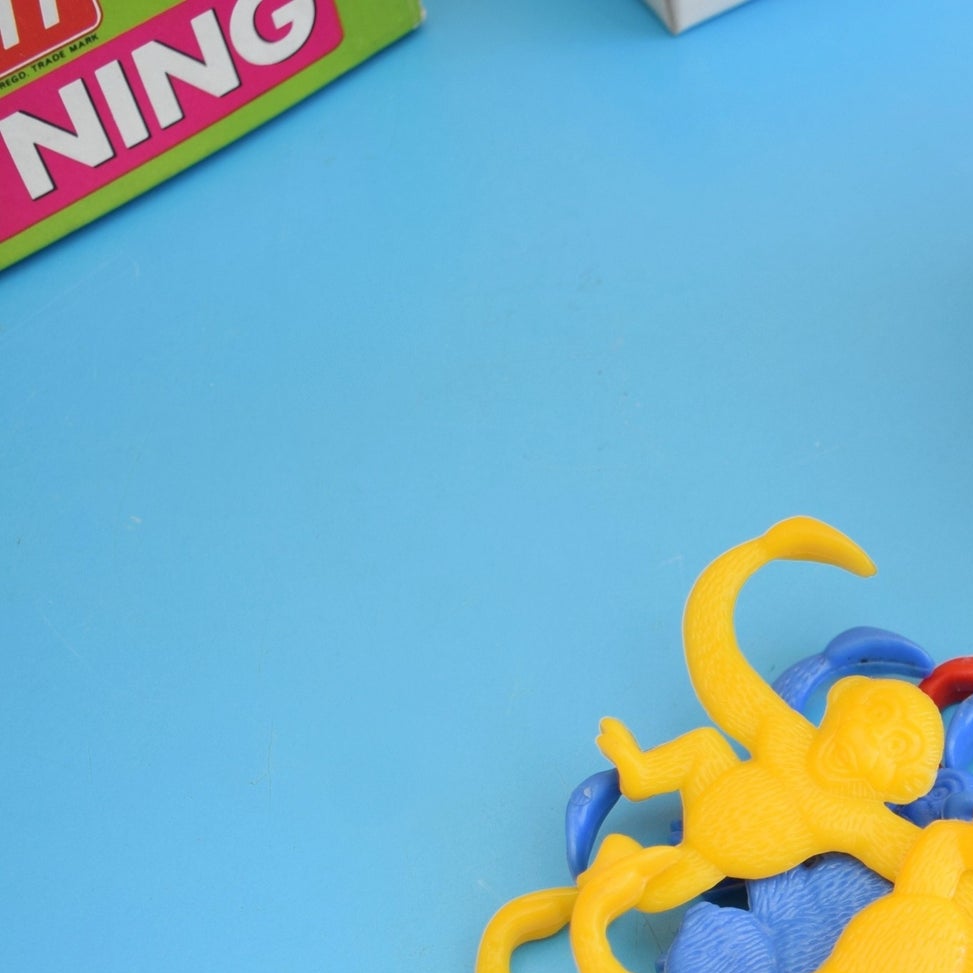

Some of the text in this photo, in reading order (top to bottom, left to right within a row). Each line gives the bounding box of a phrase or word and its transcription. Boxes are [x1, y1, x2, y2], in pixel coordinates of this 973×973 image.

[0, 0, 317, 200] NING
[31, 50, 66, 73] TRADE
[69, 33, 99, 53] MARK
